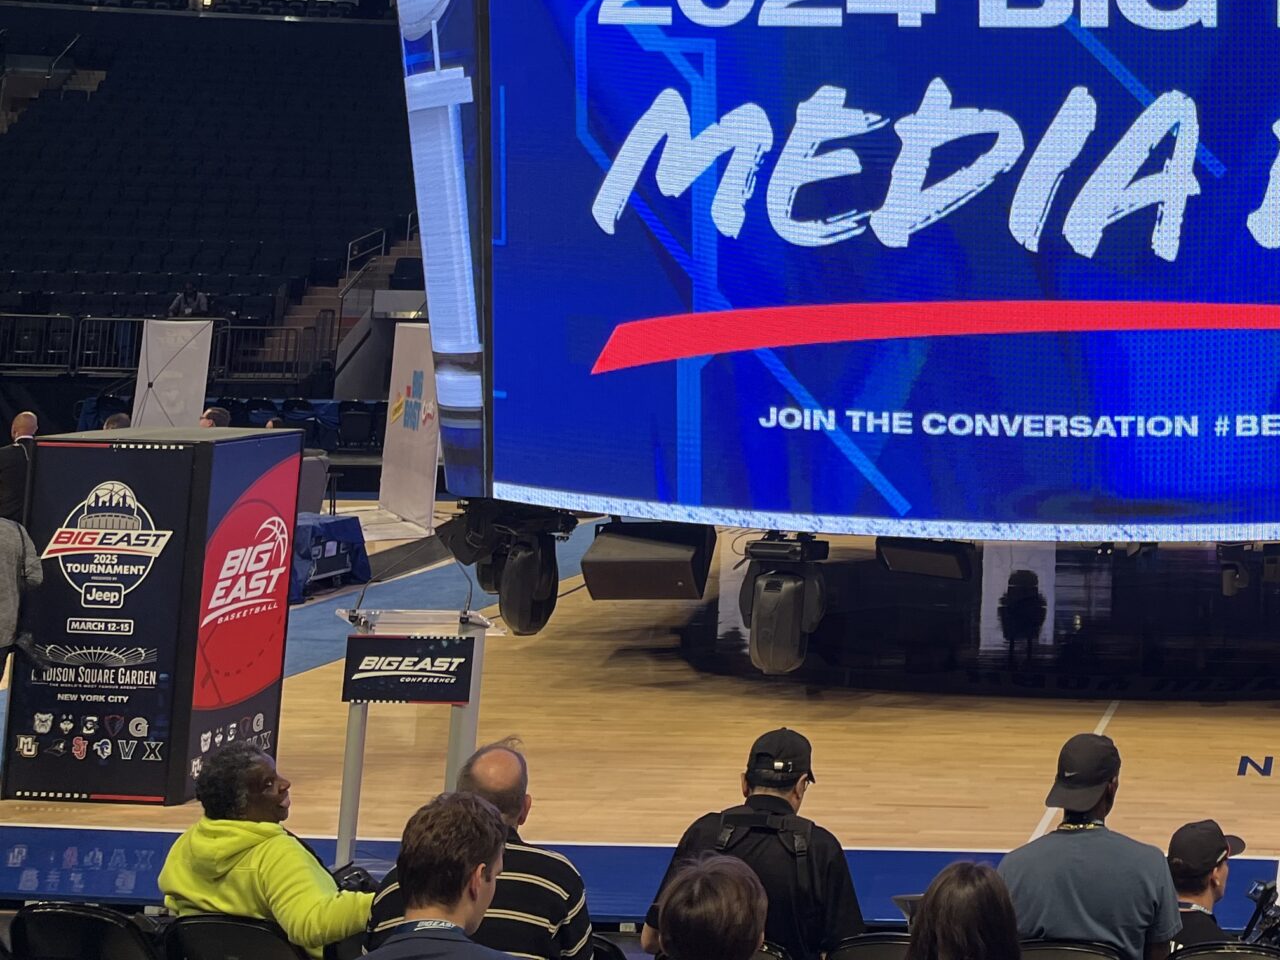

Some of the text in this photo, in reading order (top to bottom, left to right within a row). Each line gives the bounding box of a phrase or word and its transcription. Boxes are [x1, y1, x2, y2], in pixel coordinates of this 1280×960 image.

[592, 77, 1201, 262] MEDIA
[758, 407, 836, 431] JOIN
[846, 411, 913, 435] THE
[921, 413, 1199, 438] CONVERSATION
[93, 554, 118, 564] 2025
[219, 542, 275, 579] BIG
[65, 563, 146, 575] TOURNAMENT
[86, 588, 119, 604] Jeep
[208, 566, 286, 610] EAST
[217, 602, 278, 625] BASKETBALL
[71, 622, 130, 632] MARCH 12-15
[78, 666, 115, 684] SQUARE
[117, 668, 157, 686] GARDEN
[399, 676, 457, 684] CONFERENCE
[57, 693, 129, 703] NEW YORK CITY
